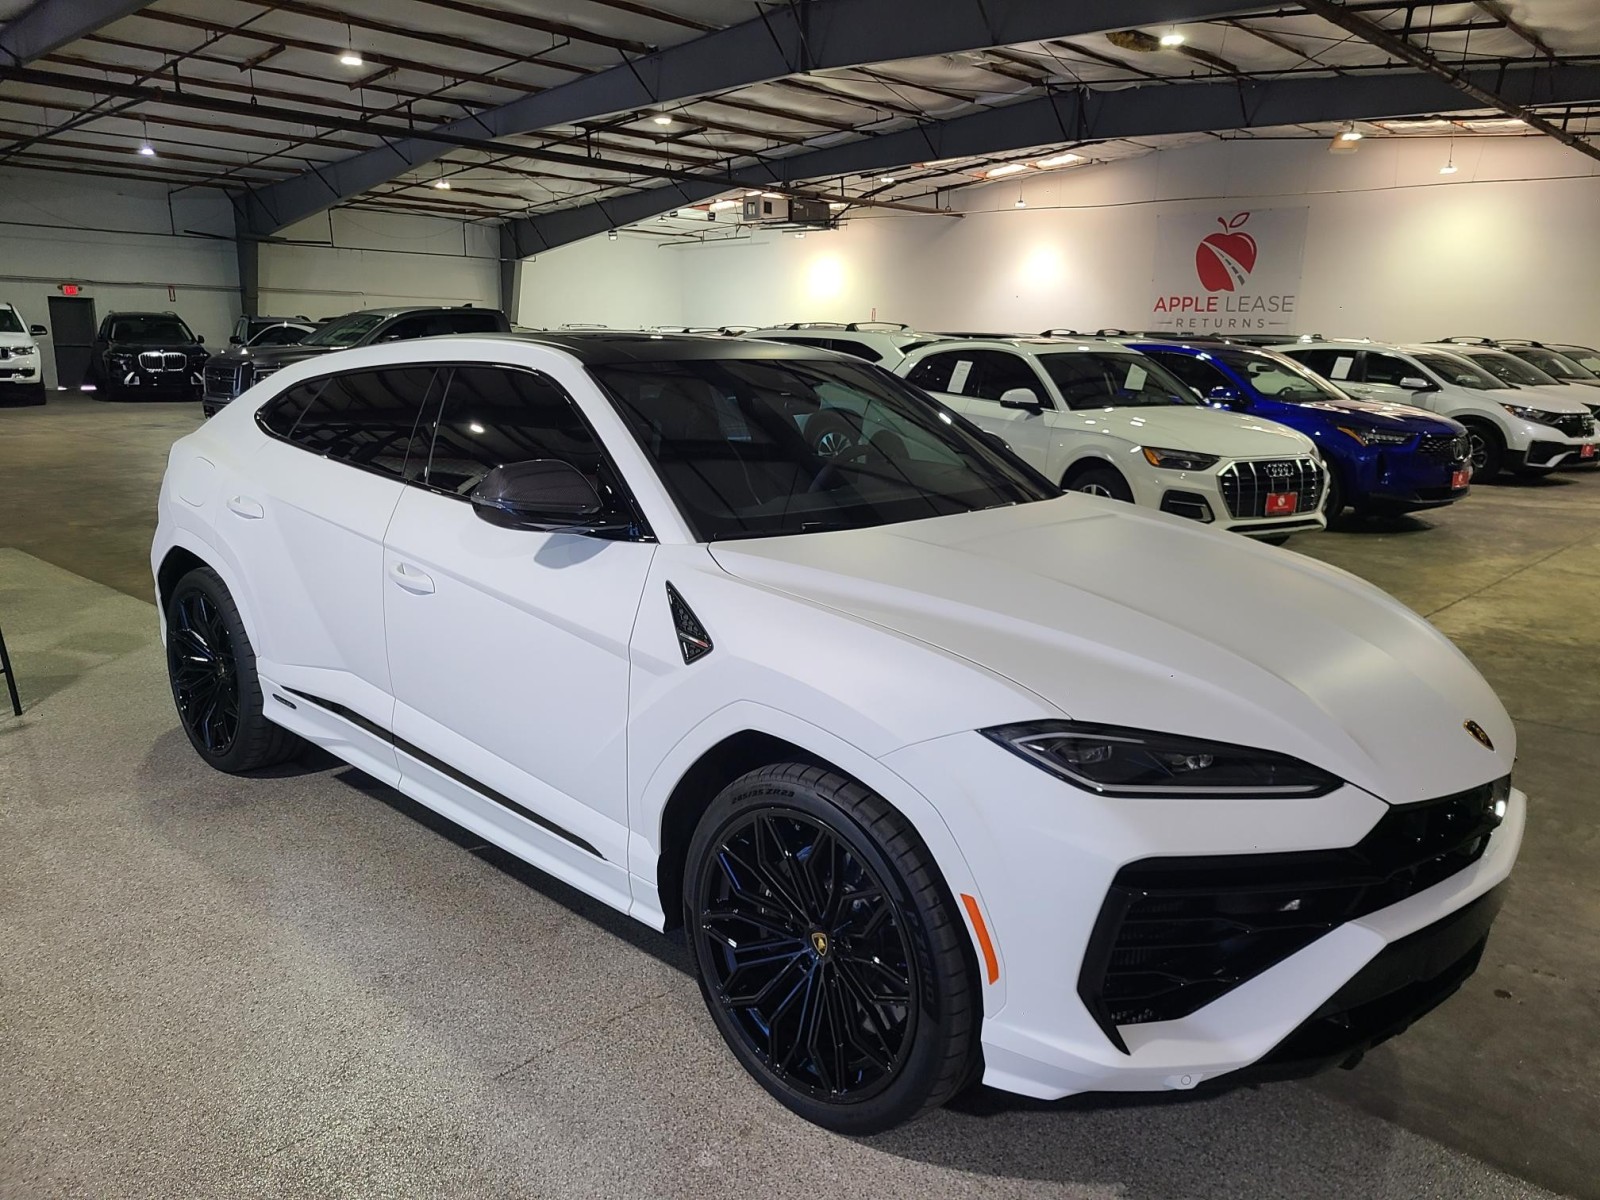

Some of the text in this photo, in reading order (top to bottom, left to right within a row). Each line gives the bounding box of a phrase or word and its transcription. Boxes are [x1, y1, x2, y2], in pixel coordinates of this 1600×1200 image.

[1154, 295, 1295, 312] APPLE LEASE
[1176, 318, 1265, 328] RETURNS
